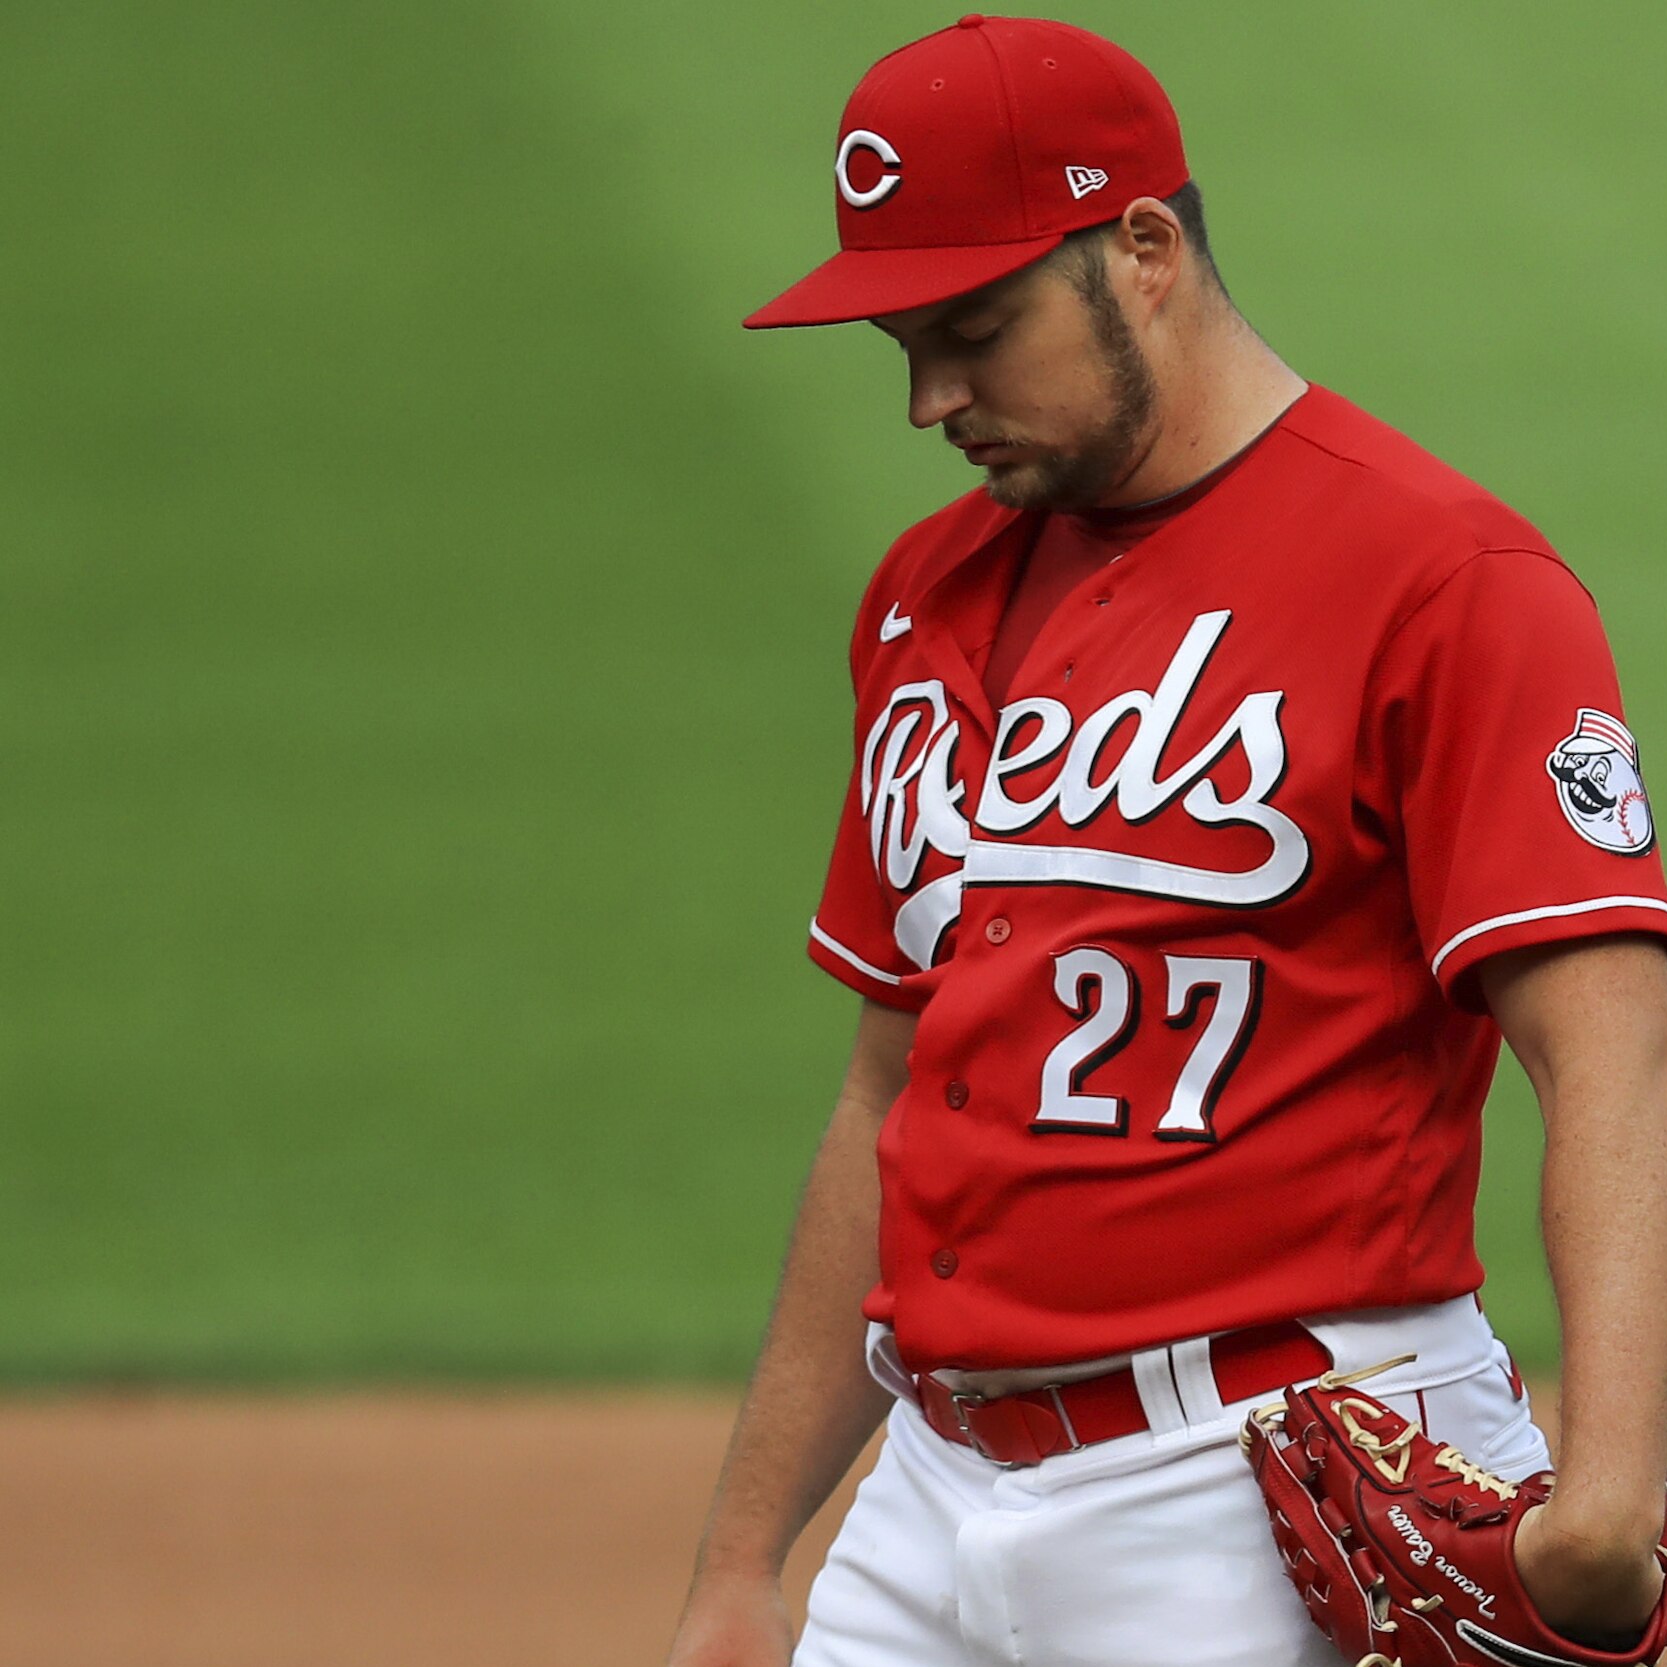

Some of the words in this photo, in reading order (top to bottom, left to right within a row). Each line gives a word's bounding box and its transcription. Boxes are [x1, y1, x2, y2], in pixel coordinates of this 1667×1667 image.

[834, 128, 902, 208] C
[1029, 943, 1263, 1142] 27
[1387, 1504, 1434, 1567] Bauer
[1434, 1555, 1496, 1621] Trevor
